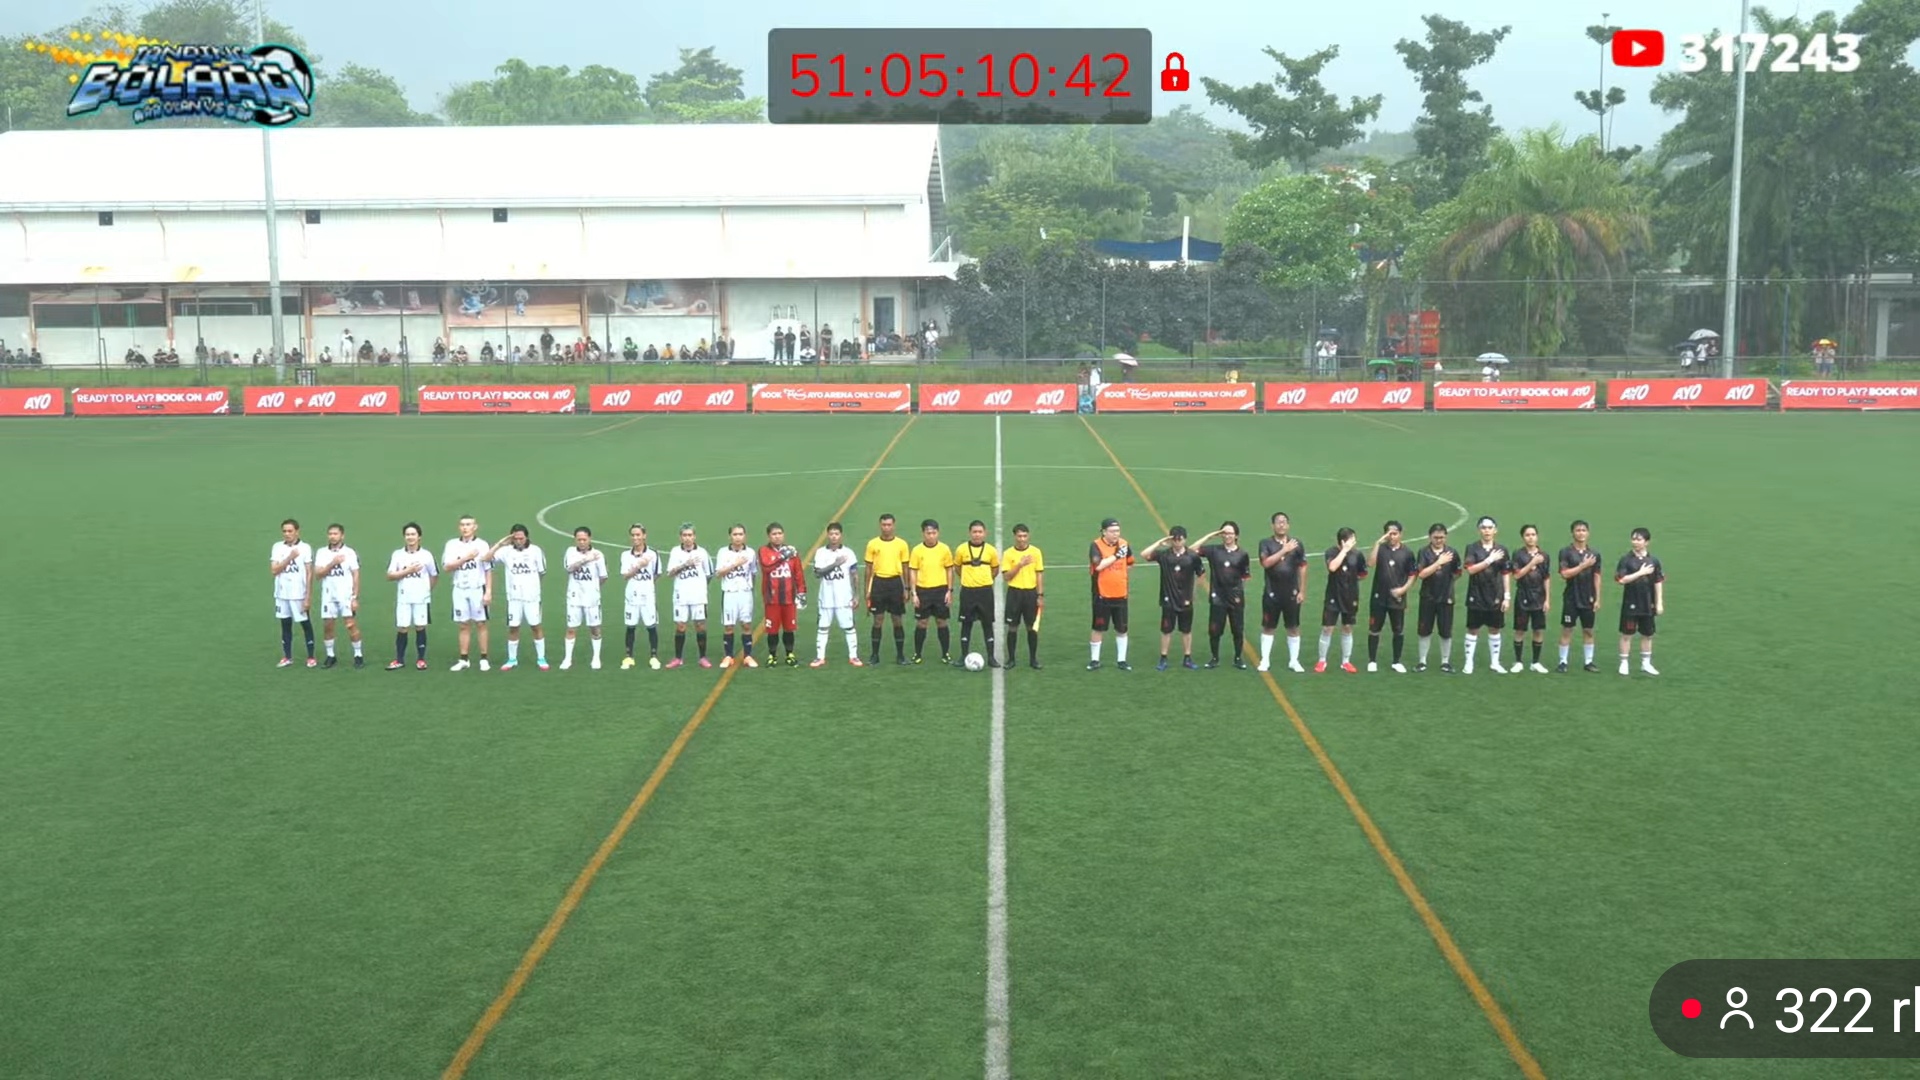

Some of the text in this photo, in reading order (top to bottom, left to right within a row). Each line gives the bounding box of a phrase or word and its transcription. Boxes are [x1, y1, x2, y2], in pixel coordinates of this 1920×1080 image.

[77, 391, 224, 403] READY TO PLAY? BOOK ON AYO
[256, 391, 286, 408] AYO
[307, 391, 336, 408] AYO
[358, 391, 388, 408] AYO
[423, 389, 571, 400] READY TO PLAY? BOOK ON AYO
[602, 389, 631, 407] AYO
[654, 389, 683, 406] AYO
[705, 389, 735, 406] AYO
[760, 391, 782, 399] BOOK
[825, 391, 853, 399] ARENA
[854, 391, 874, 399] ONLY
[876, 391, 888, 399] ON
[931, 389, 961, 406] AYO
[983, 389, 1012, 406] AYO
[1035, 389, 1065, 406] AYO
[1104, 391, 1126, 399] BOOK
[1169, 390, 1198, 398] ARENA
[1199, 390, 1219, 398] ONLY
[1220, 390, 1232, 398] ON
[1277, 388, 1307, 405] AYO
[1329, 387, 1360, 404] AYO
[1382, 387, 1412, 404] AYO
[1439, 386, 1591, 397] READY TO PLAY? BOOK ON AYO
[1672, 383, 1703, 400] AYO
[1724, 383, 1755, 400] AYO
[1786, 387, 1918, 396] READY TO PLAY? BOOK ON
[24, 393, 52, 410] AYO
